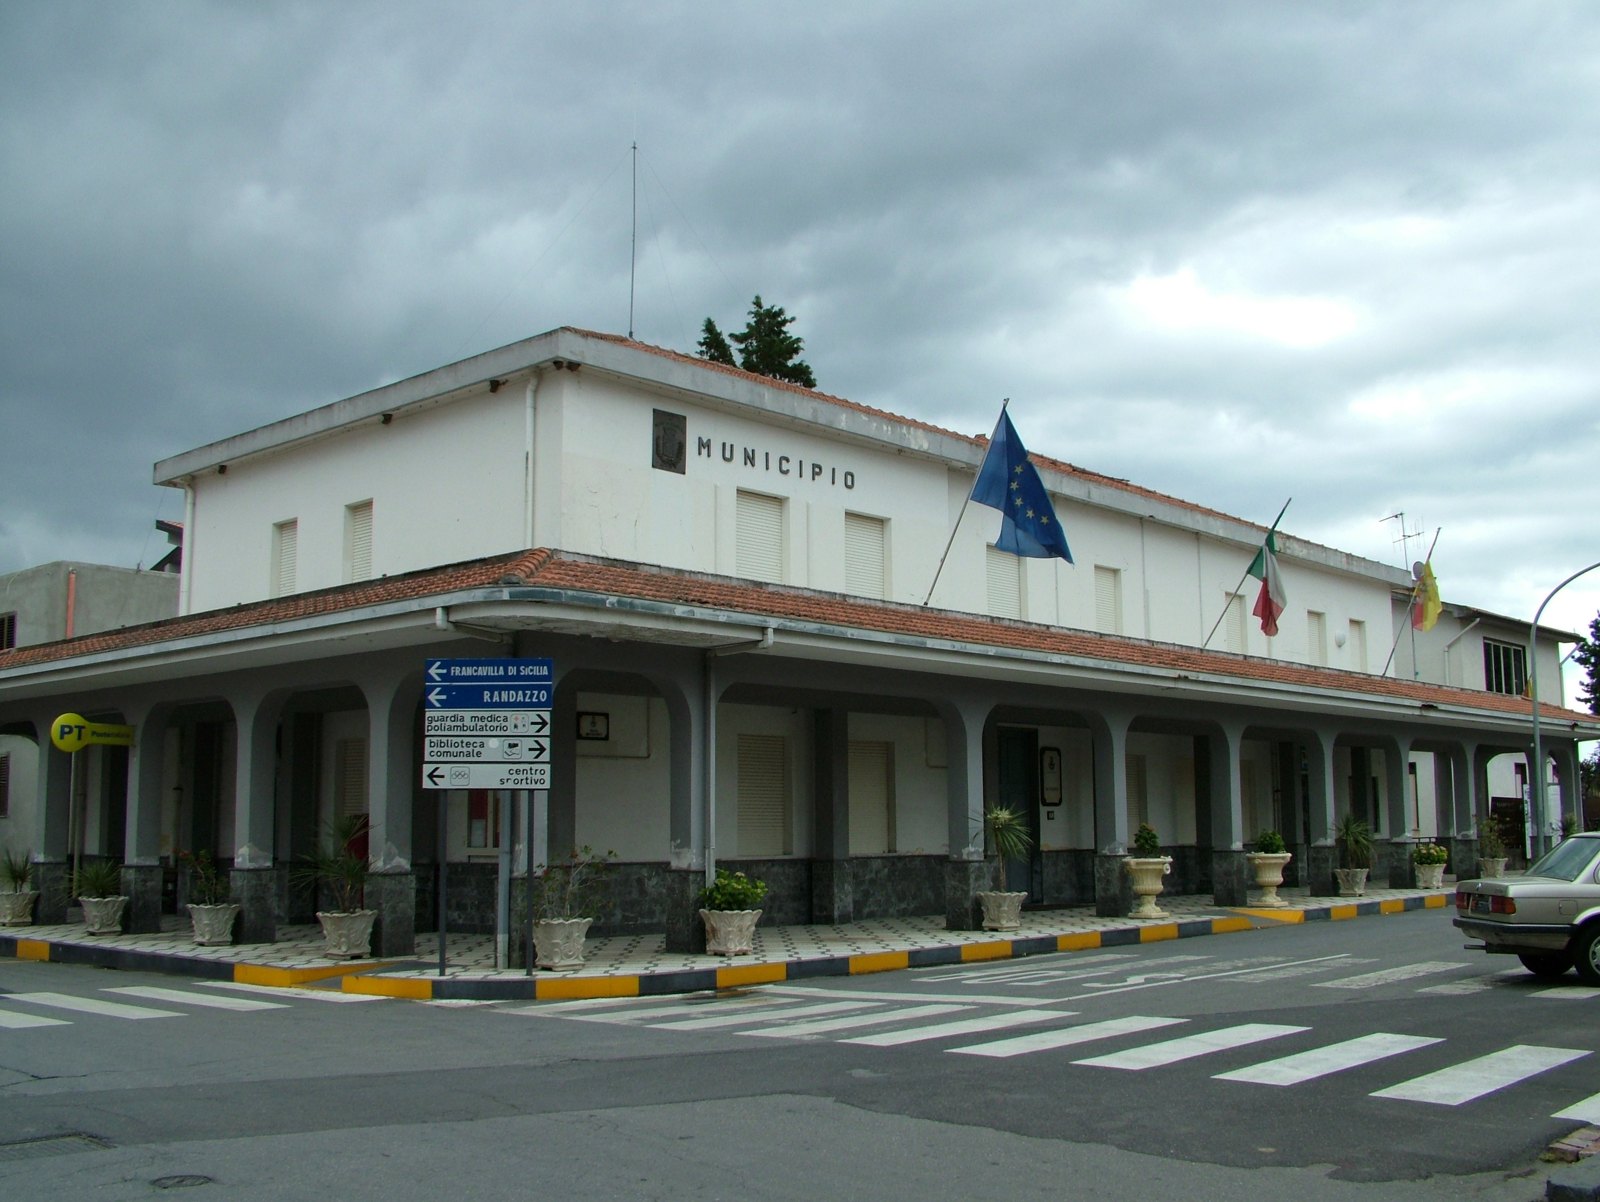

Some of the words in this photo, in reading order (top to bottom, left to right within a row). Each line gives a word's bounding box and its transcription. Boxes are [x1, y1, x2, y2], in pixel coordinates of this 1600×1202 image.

[697, 436, 855, 490] MUNICIPIO
[450, 666, 504, 676] FRANCAVILLA
[508, 666, 516, 675] DI
[483, 690, 548, 702] RANDAZZO
[426, 714, 465, 724] guardia
[470, 714, 508, 722] medica
[59, 724, 86, 740] PT
[426, 722, 508, 733] poliambulatorio
[429, 739, 485, 748] biblioteca
[429, 749, 482, 757] comunale
[508, 766, 546, 775] centro
